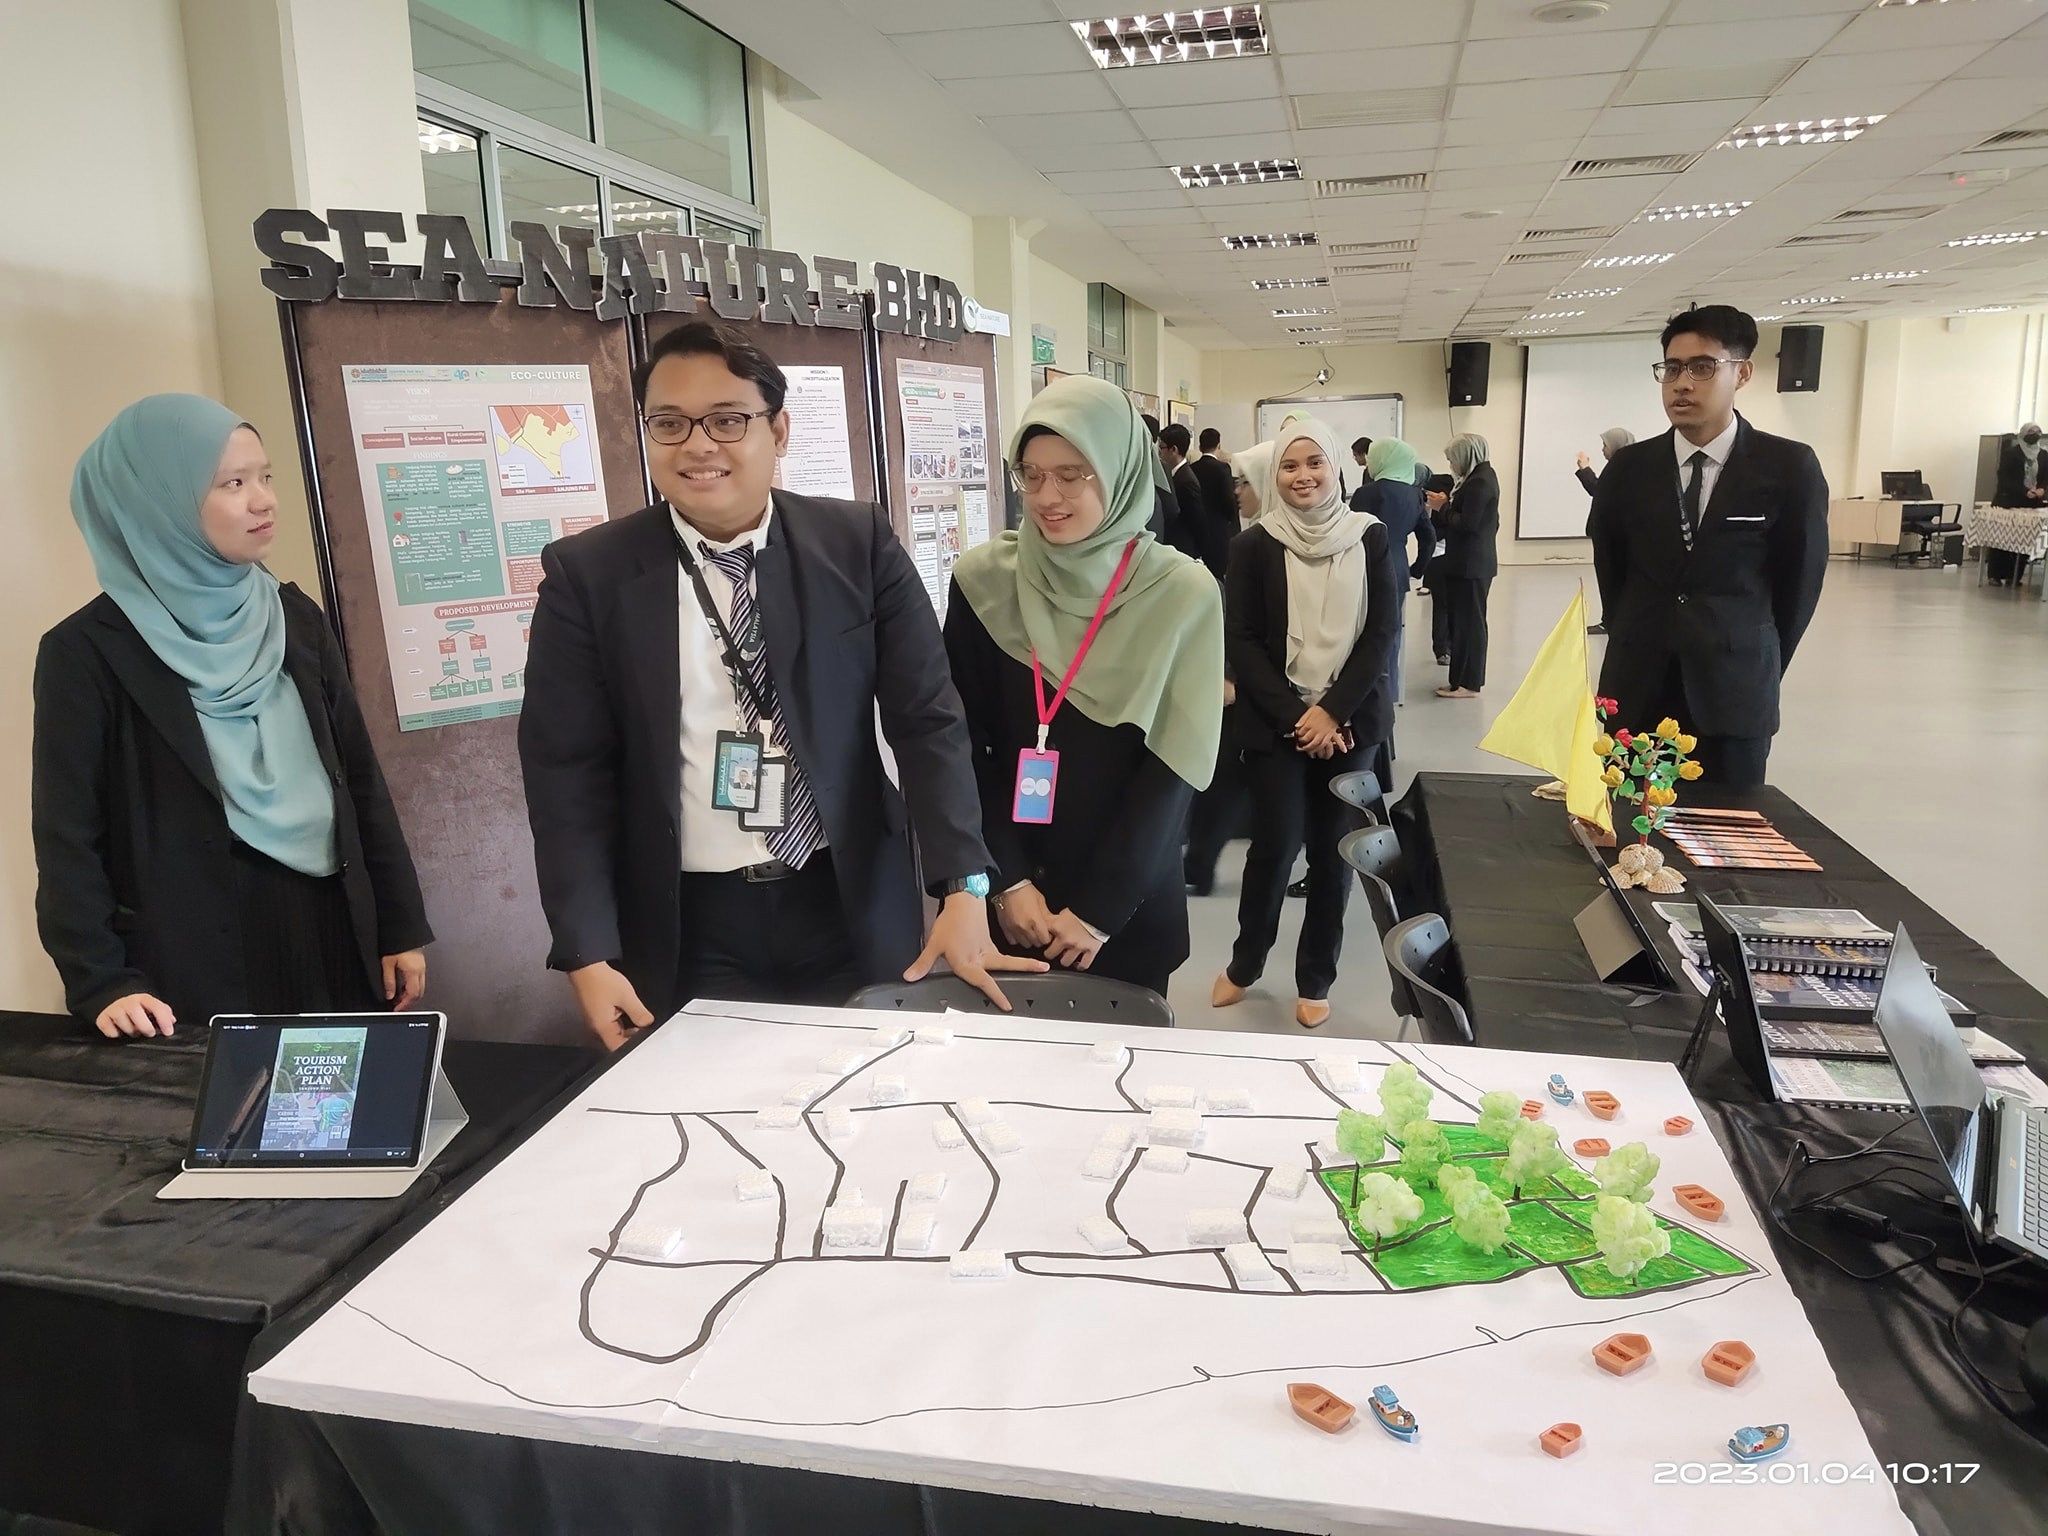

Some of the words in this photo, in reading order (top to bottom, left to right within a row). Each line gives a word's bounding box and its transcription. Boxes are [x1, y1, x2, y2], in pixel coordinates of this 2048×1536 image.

[253, 208, 501, 302] SEA
[510, 220, 864, 330] NATURE
[872, 260, 965, 343] BHD
[510, 371, 581, 380] ECO-CULTURE
[439, 606, 479, 617] PROPOSED
[481, 600, 534, 612] DEVELOPMENT
[294, 1056, 347, 1065] TOURISM
[295, 1066, 341, 1075] ACTION
[301, 1076, 333, 1085] PLAN
